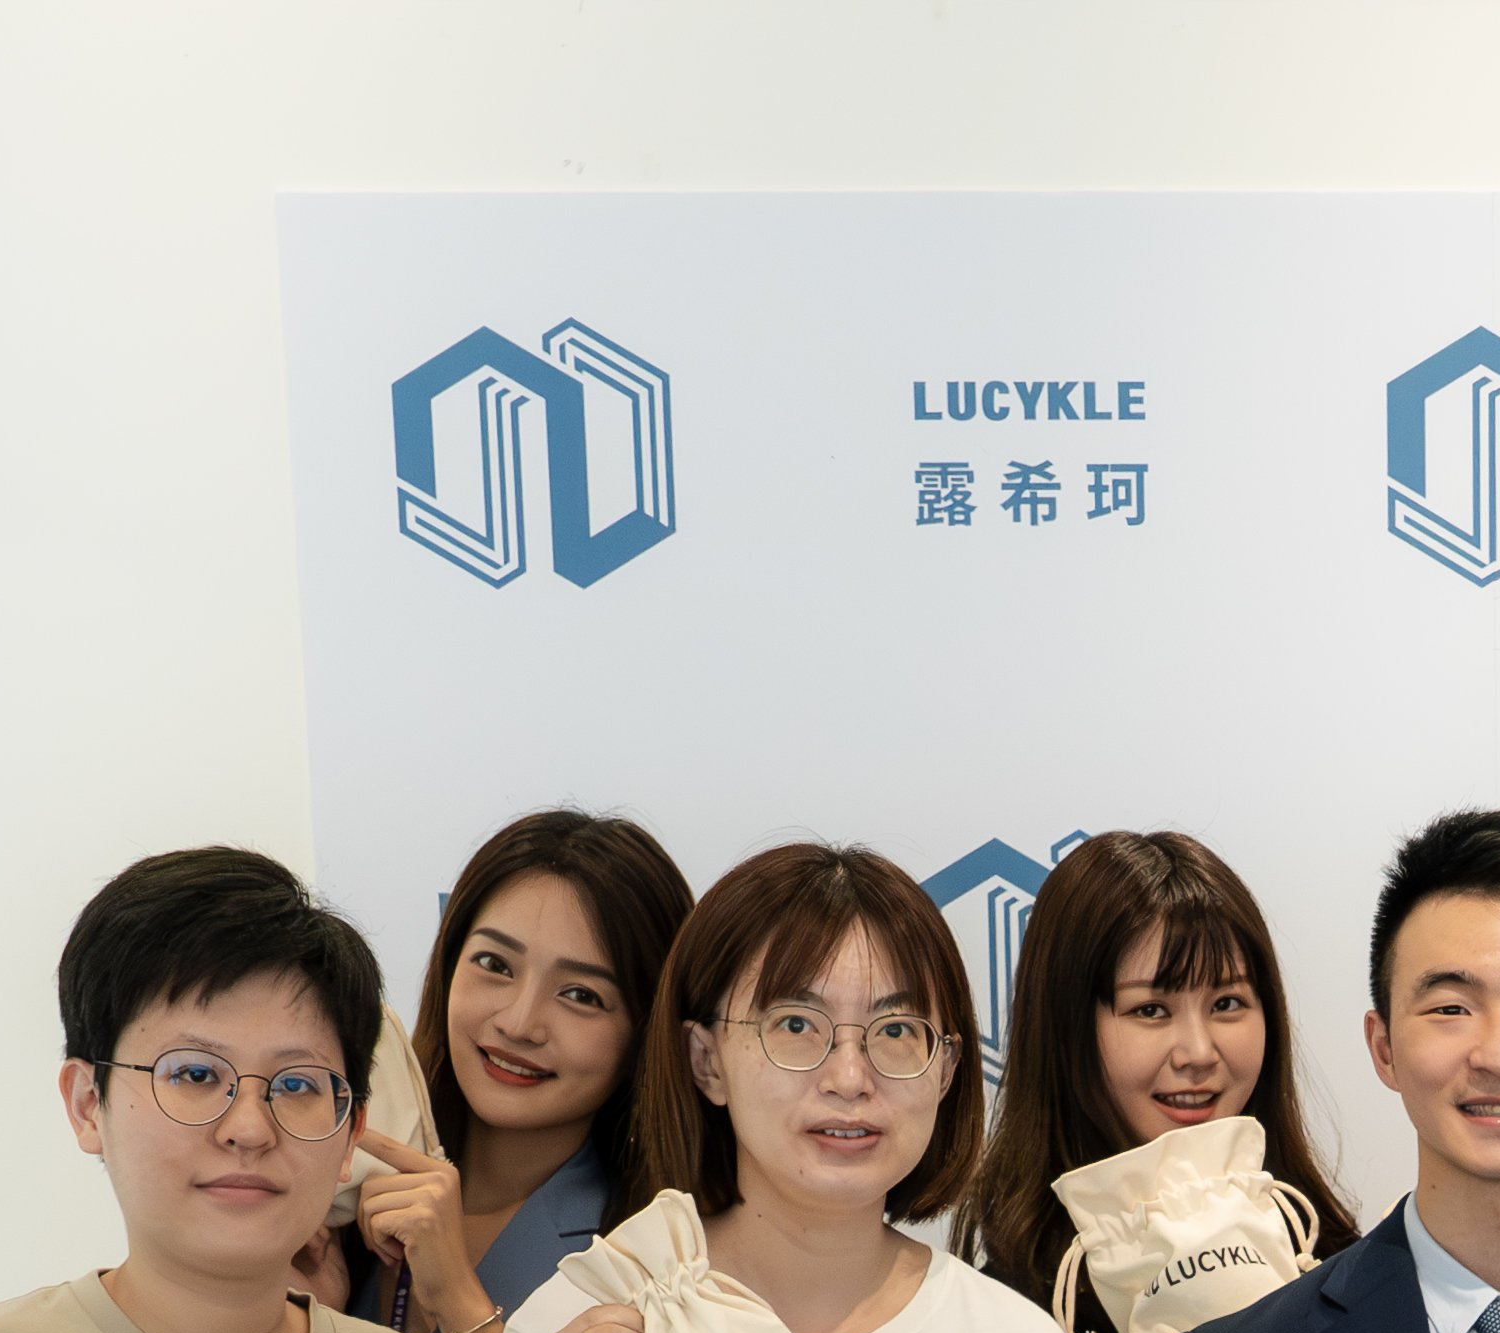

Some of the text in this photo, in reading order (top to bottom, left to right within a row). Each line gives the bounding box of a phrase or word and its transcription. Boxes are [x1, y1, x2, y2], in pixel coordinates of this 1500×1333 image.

[913, 381, 1146, 422] LUCYKLE
[914, 461, 1149, 527] 露希珂
